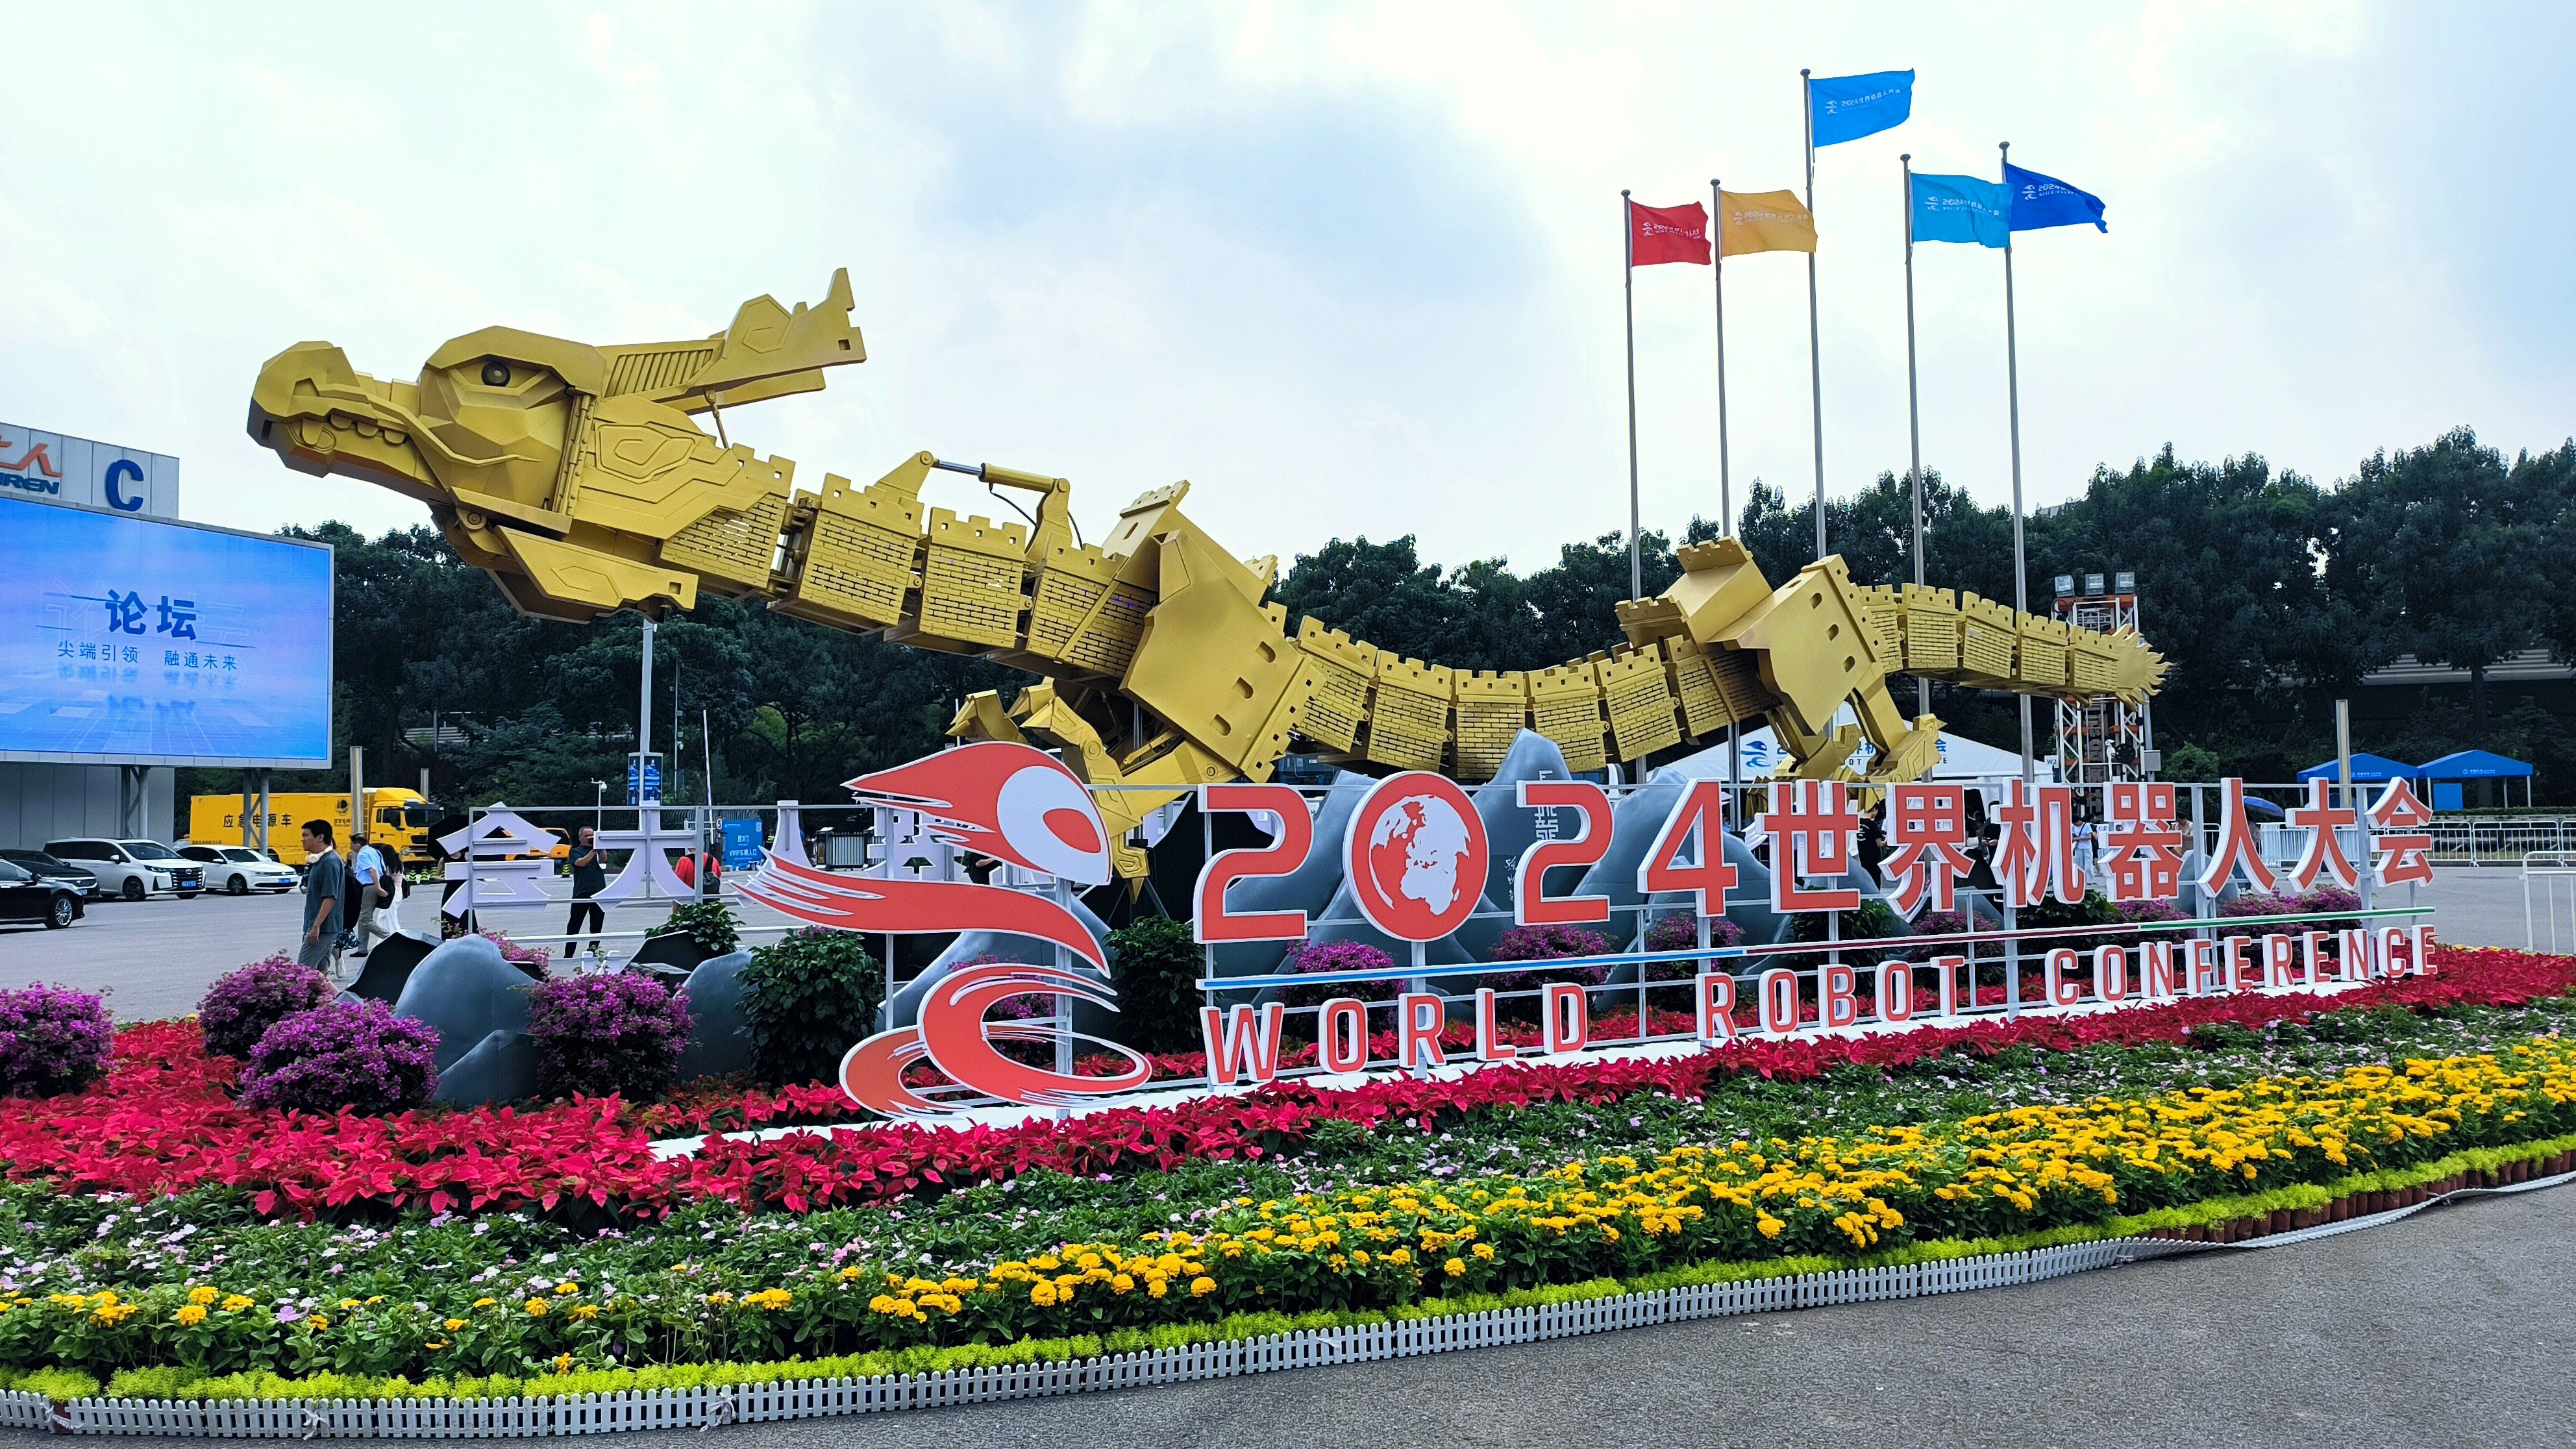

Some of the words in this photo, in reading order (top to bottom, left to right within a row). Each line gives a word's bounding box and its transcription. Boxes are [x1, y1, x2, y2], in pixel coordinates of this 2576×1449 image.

[106, 459, 144, 512] C
[105, 589, 197, 641] 论坛
[57, 639, 140, 663] 尖端引领
[163, 649, 238, 671] 融通未来
[223, 813, 292, 828] 应急电源车
[1193, 771, 2434, 944] 2024世界机器人大会
[1200, 983, 1589, 1086] WORLD
[1694, 955, 1965, 1040] ROBOT
[2044, 924, 2438, 1006] CONFERENCE
